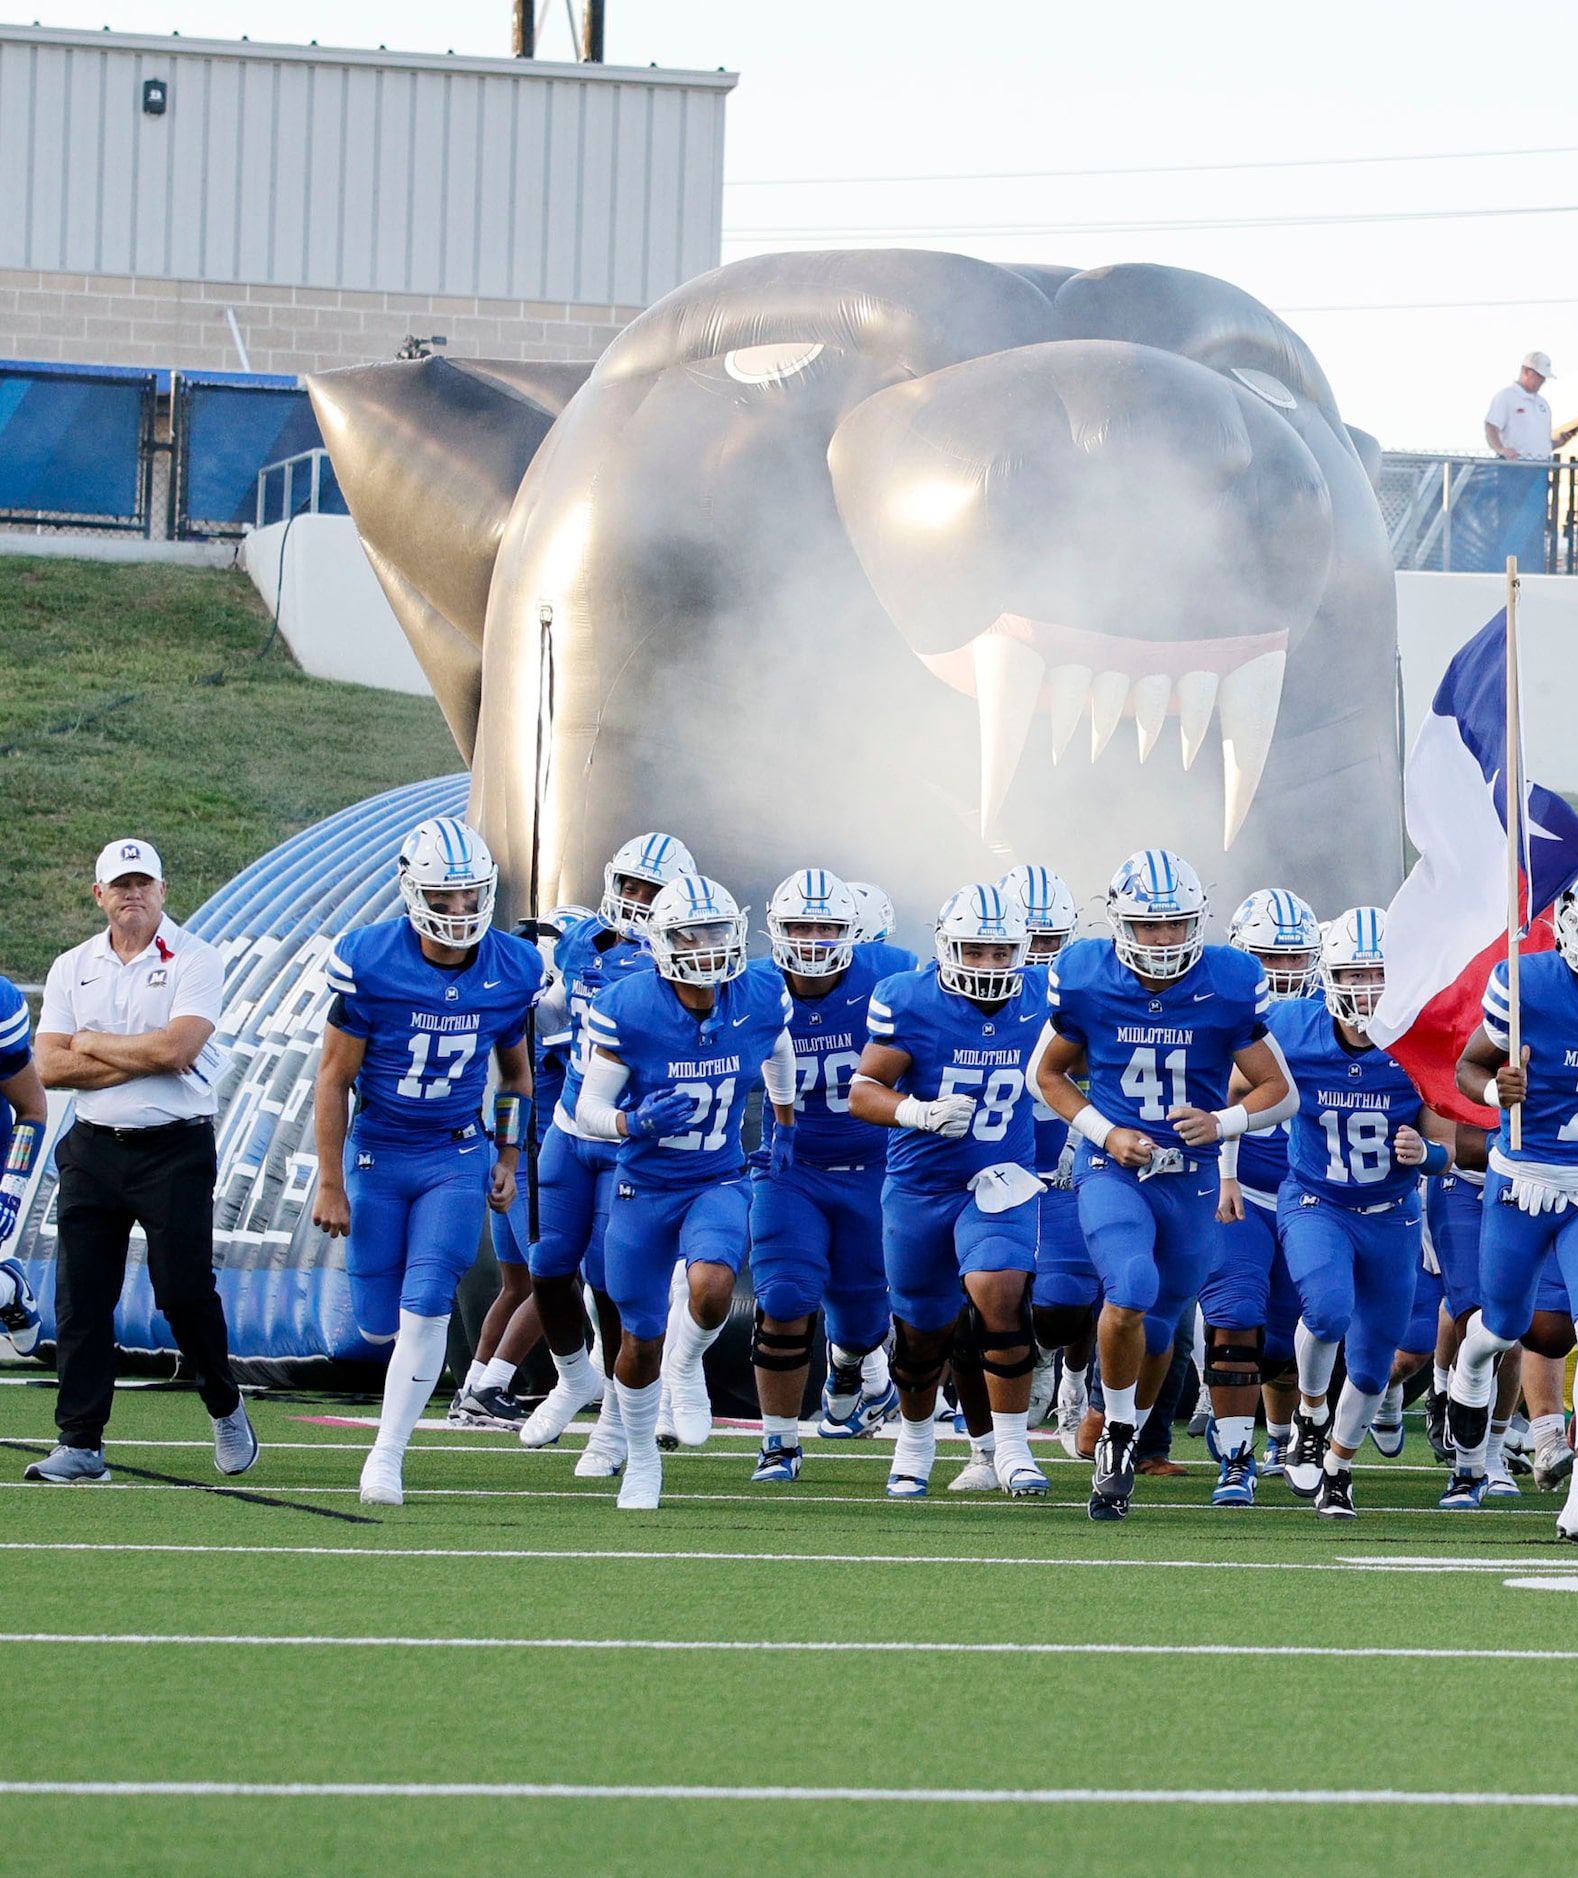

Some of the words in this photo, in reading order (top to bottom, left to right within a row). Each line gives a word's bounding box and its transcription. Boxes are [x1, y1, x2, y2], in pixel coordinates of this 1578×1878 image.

[410, 1011, 481, 1032] MIDLOTHIAN
[793, 1032, 853, 1053] IDLOTHIAN
[1116, 1026, 1194, 1046] MIDLOTHIAN
[396, 1032, 478, 1099] 17
[667, 1055, 740, 1078] MIDLOTHIAN
[952, 1049, 1021, 1066] MIDLOTHIAN
[1119, 1047, 1193, 1121] 41
[1317, 1089, 1391, 1110] MIDLOTHIAN
[657, 1077, 737, 1151] 21
[1318, 1109, 1391, 1184] 18
